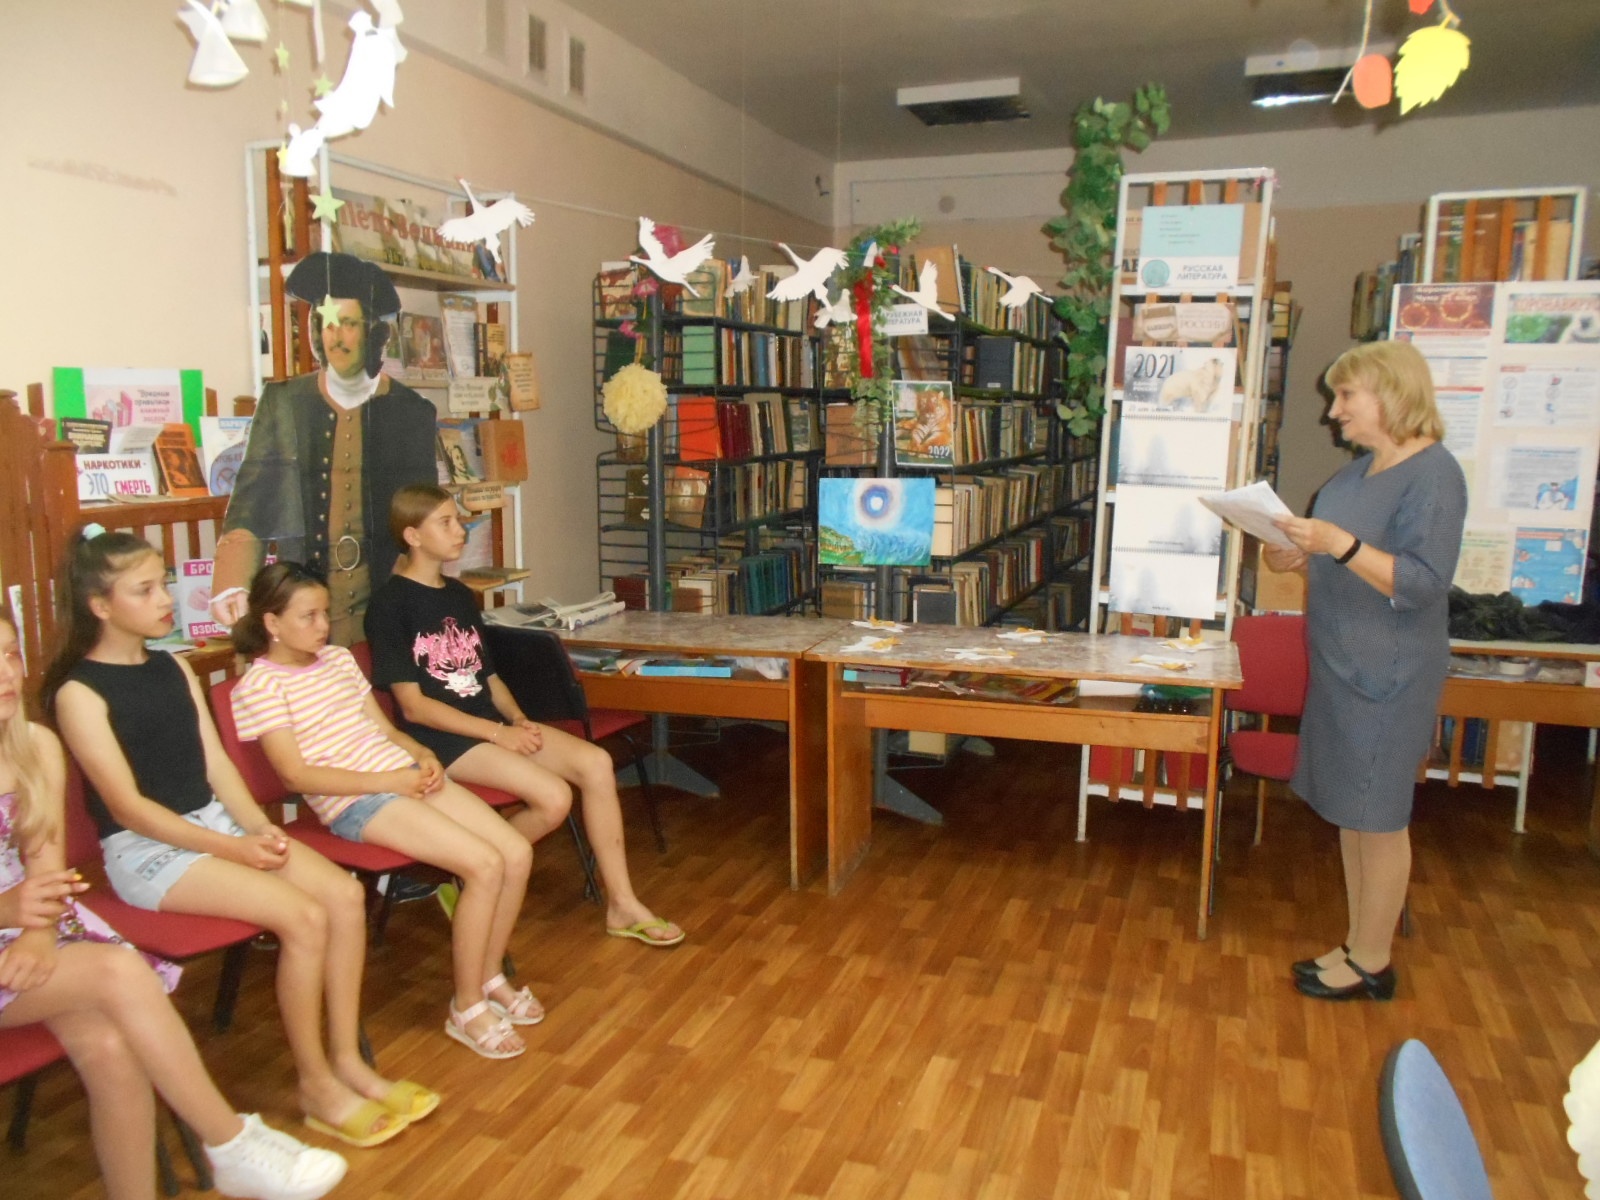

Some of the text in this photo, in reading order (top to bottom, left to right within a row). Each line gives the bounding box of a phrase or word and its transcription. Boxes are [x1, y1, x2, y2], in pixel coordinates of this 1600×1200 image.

[1183, 264, 1223, 272] РУССКАЯ
[1177, 272, 1228, 280] ЛИТЕРАТУРА
[884, 310, 923, 319] РУБЕЖНАЯ
[887, 317, 921, 326] ТЕРАТУРА
[1133, 353, 1175, 379] 2021
[927, 445, 950, 459] 2022
[83, 460, 142, 470] НАРКОТИКИ
[86, 473, 110, 495] ЭТО
[114, 480, 151, 495] СМЕРТЬ
